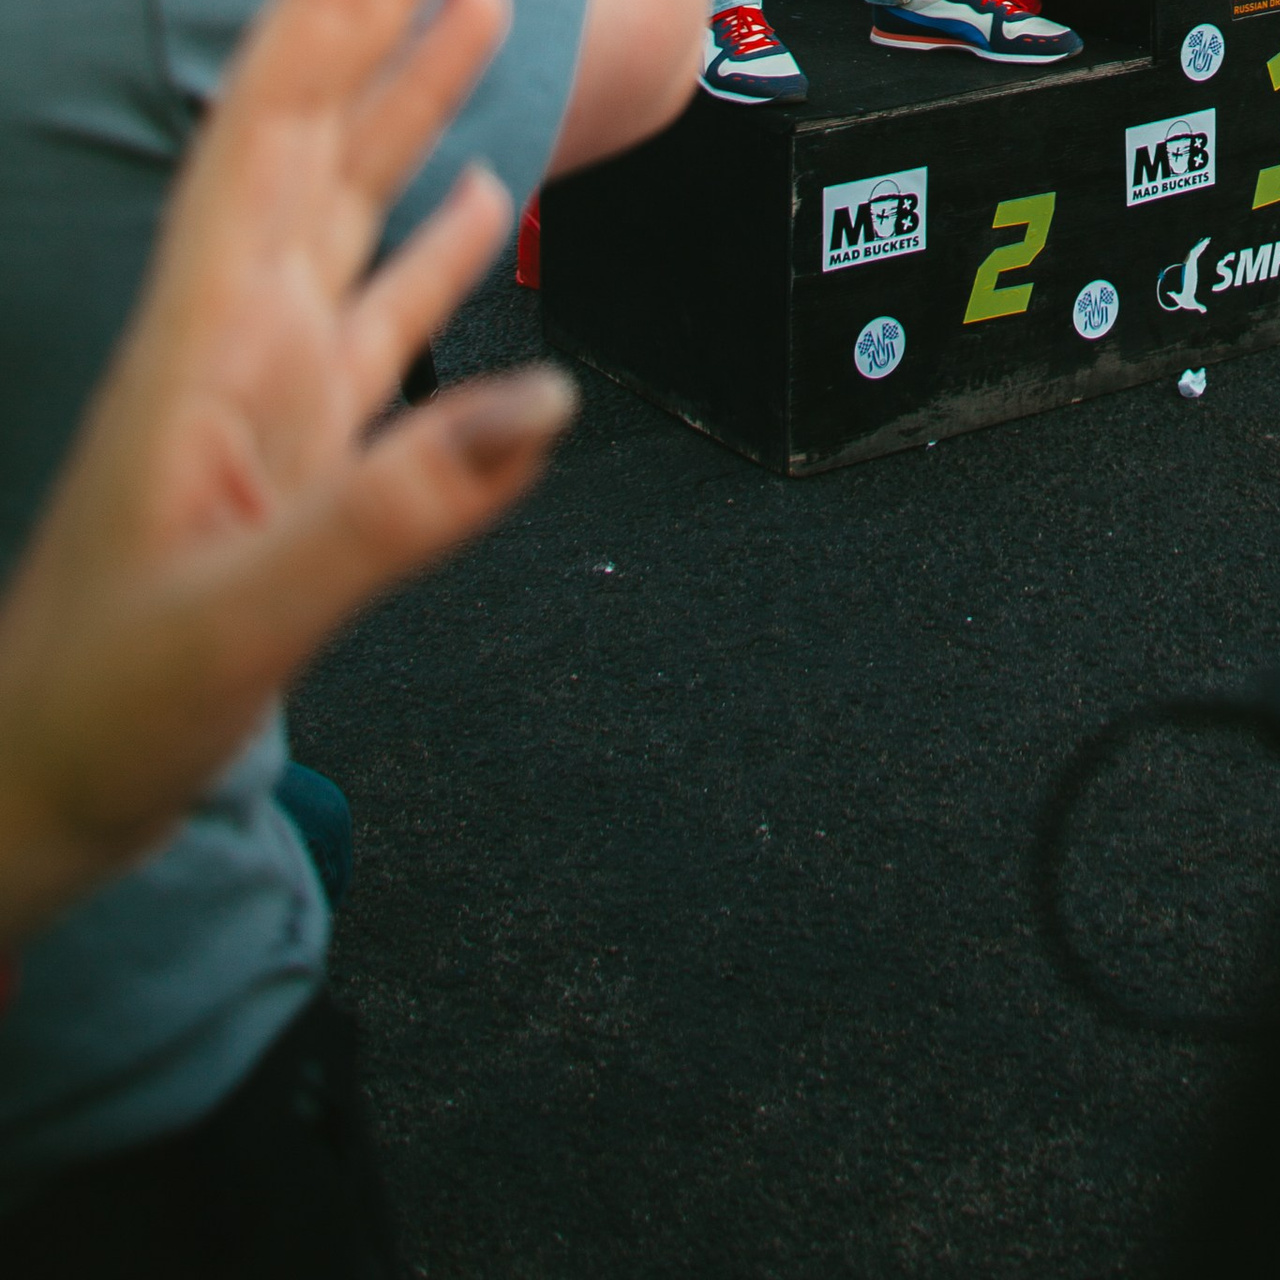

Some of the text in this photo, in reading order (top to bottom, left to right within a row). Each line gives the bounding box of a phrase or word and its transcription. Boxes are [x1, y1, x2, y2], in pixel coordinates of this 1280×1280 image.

[1233, 0, 1268, 15] RUSSIAN
[1132, 172, 1210, 201] MAD BUCKETS
[829, 236, 920, 266] MAD BUCKETS
[963, 191, 1057, 325] 2
